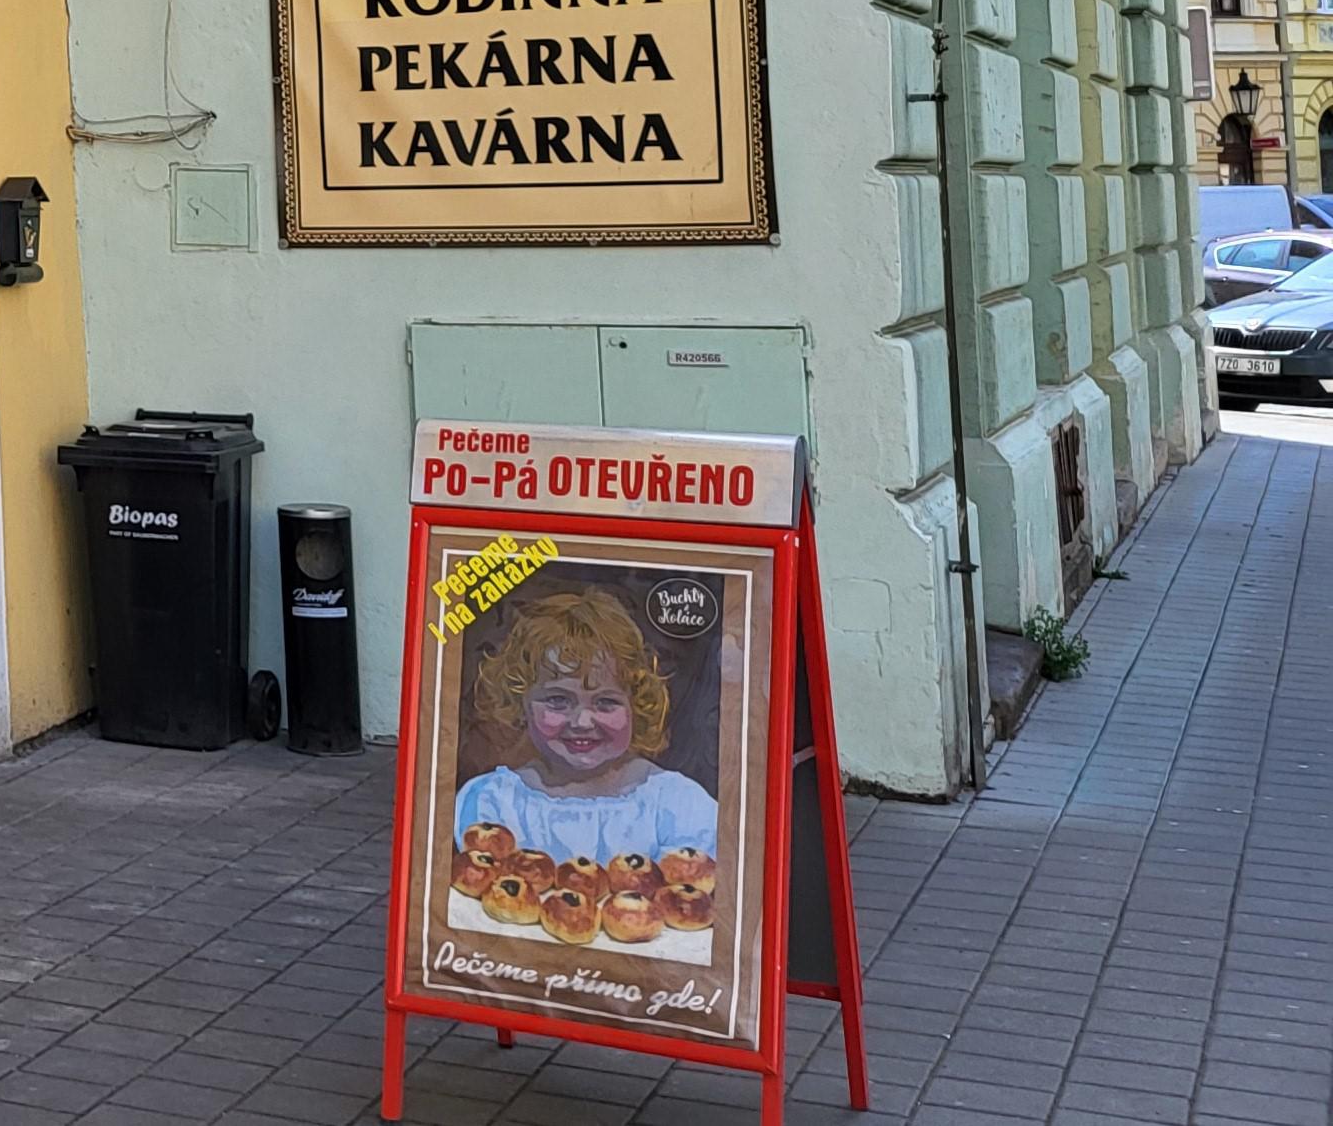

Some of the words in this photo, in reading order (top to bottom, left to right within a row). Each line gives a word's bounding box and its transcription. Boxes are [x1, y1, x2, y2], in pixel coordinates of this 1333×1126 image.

[358, 30, 675, 92] PEKÁRNA
[357, 107, 684, 168] KAVÁRNA
[1247, 360, 1275, 372] 3610
[438, 427, 530, 455] Pečeme
[548, 454, 755, 507] OTEVŘENO
[109, 504, 178, 529] Biopas
[432, 533, 519, 606] Pečeme
[443, 603, 476, 635] na
[469, 534, 560, 613] zakázku
[657, 587, 705, 608] Buchty
[433, 940, 538, 984] Pečeme
[545, 969, 643, 1002] přímo
[647, 979, 723, 1017] zde!
